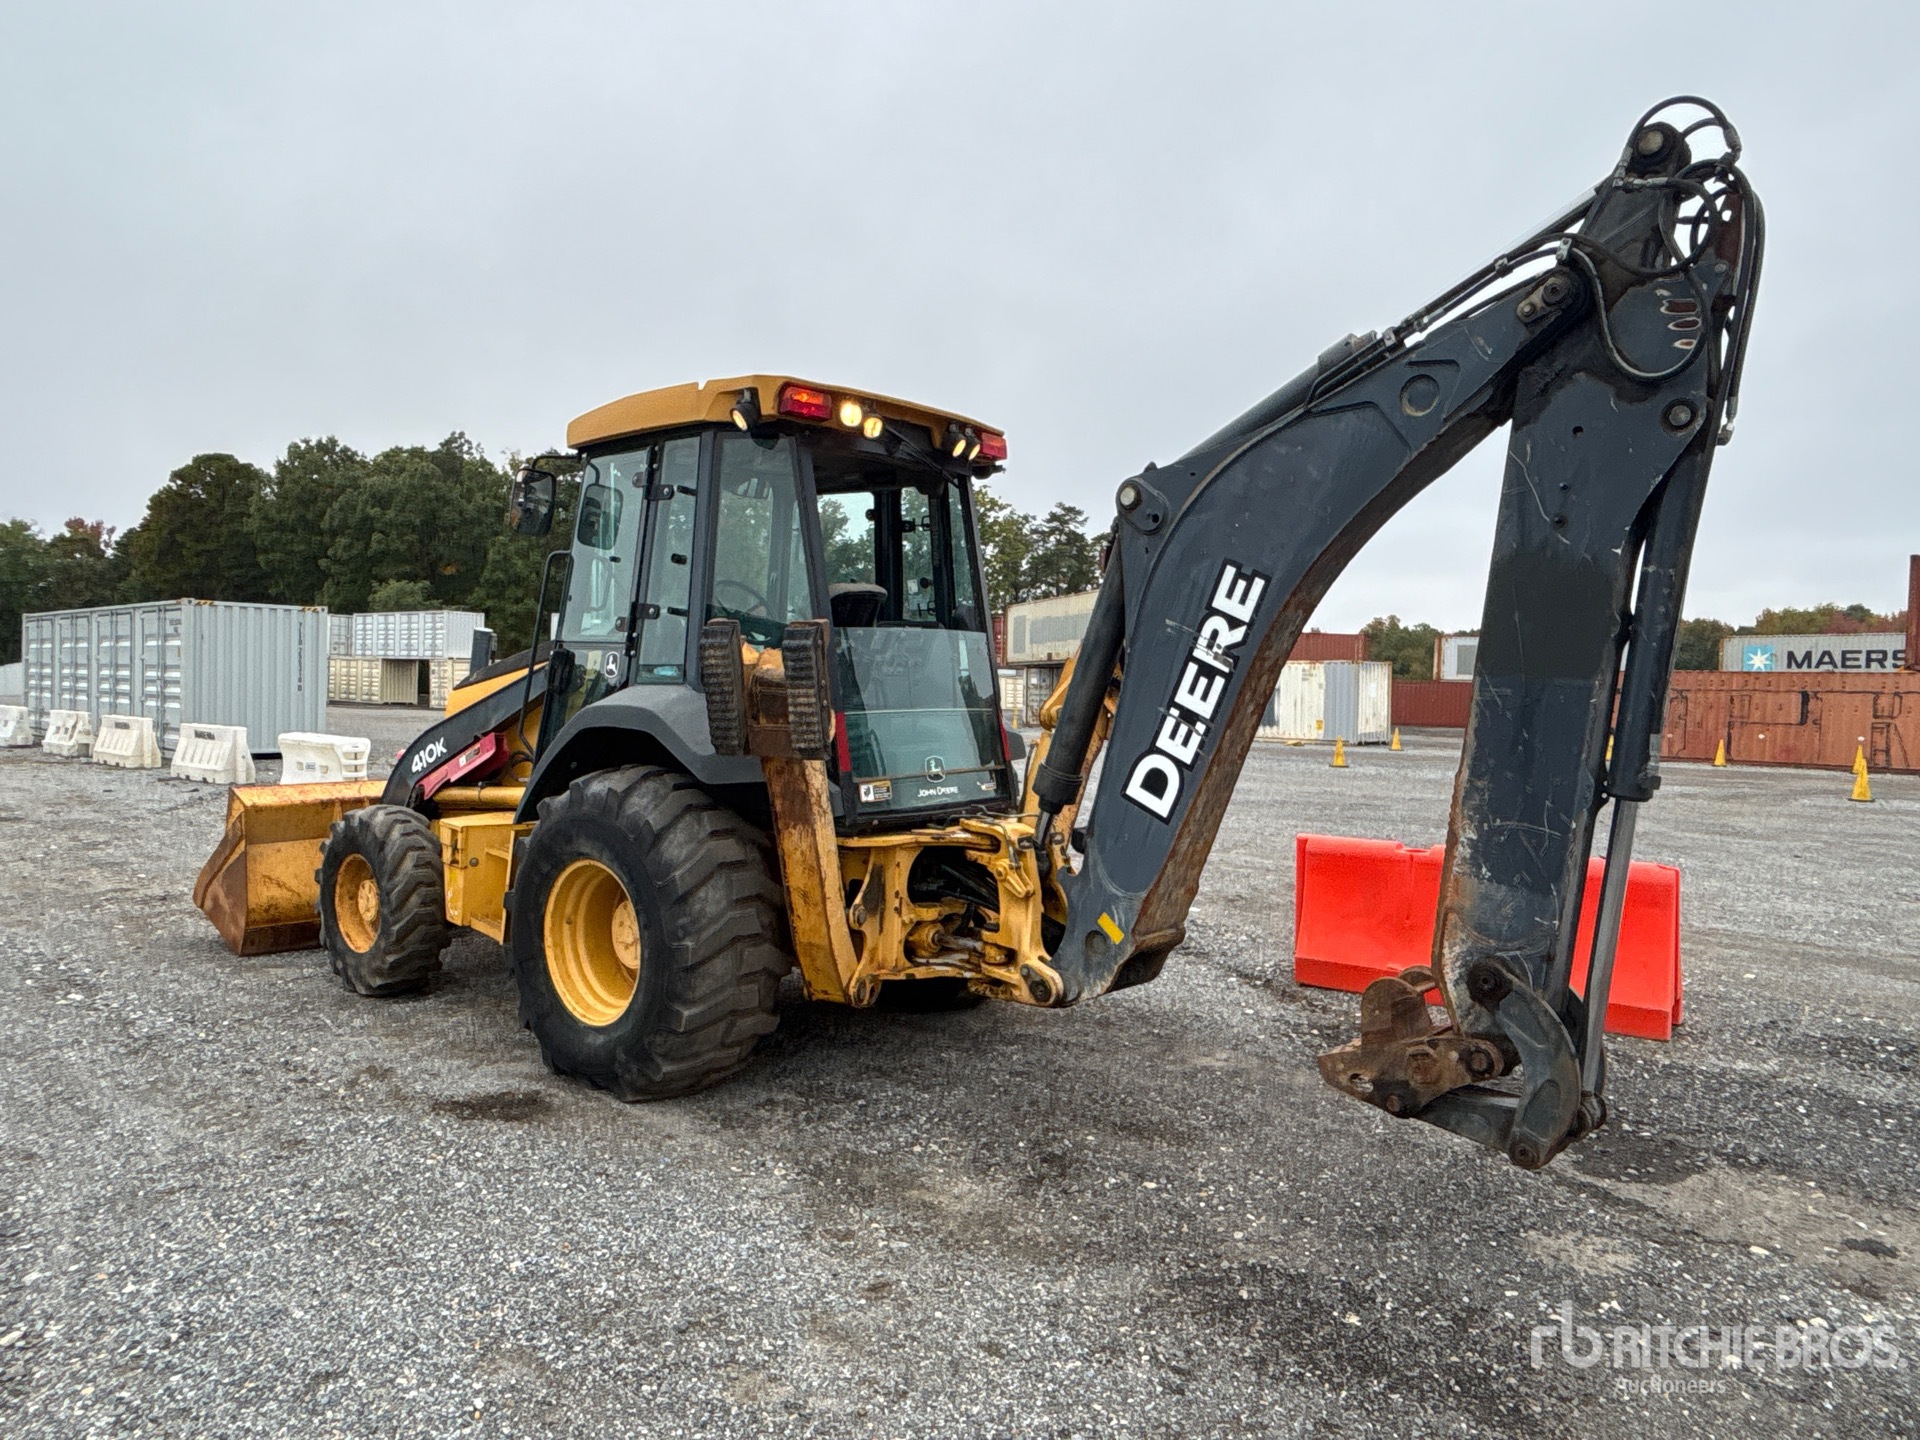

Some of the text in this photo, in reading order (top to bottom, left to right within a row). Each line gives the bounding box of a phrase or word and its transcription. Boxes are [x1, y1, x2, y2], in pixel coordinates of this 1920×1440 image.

[1787, 649, 1906, 669] MAERS
[1125, 564, 1266, 819] DEERE
[411, 736, 447, 773] 410K
[917, 788, 937, 798] JOHN
